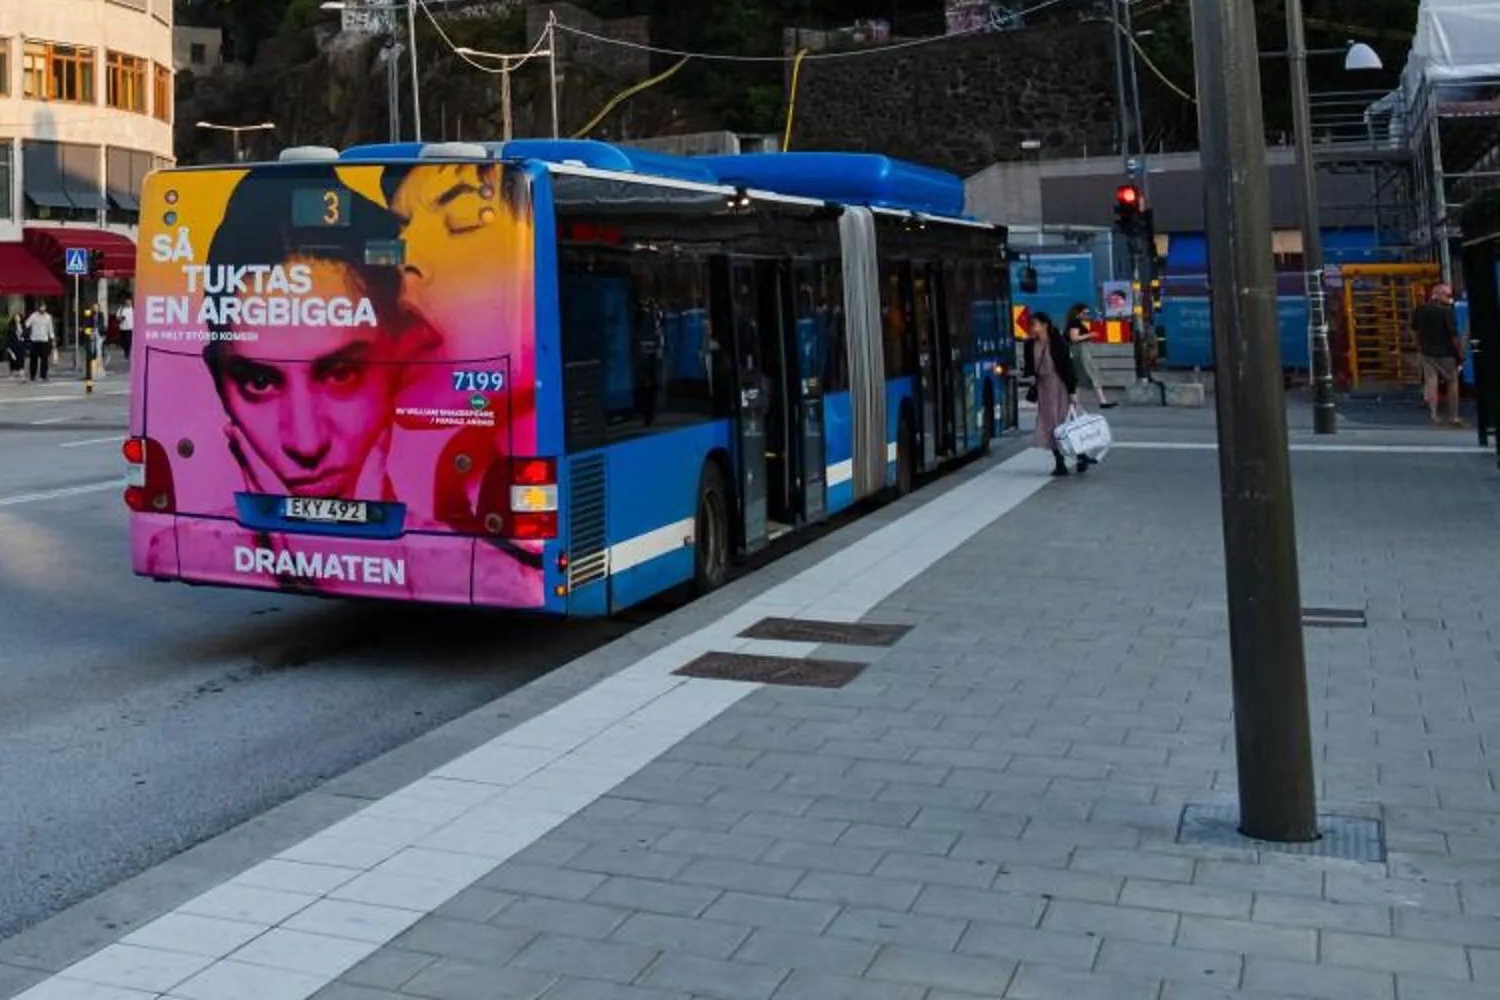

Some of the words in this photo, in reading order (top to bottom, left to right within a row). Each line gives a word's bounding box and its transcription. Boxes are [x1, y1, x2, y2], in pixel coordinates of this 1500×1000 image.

[323, 191, 340, 226] 3
[151, 227, 194, 262] SÅ
[181, 264, 312, 294] TUKTAS
[146, 296, 189, 325] EN
[196, 296, 377, 327] ARGBIGGA
[452, 371, 504, 391] 7199
[292, 498, 323, 517] EKY
[327, 501, 361, 519] 492
[234, 545, 406, 586] DRAMATEN
